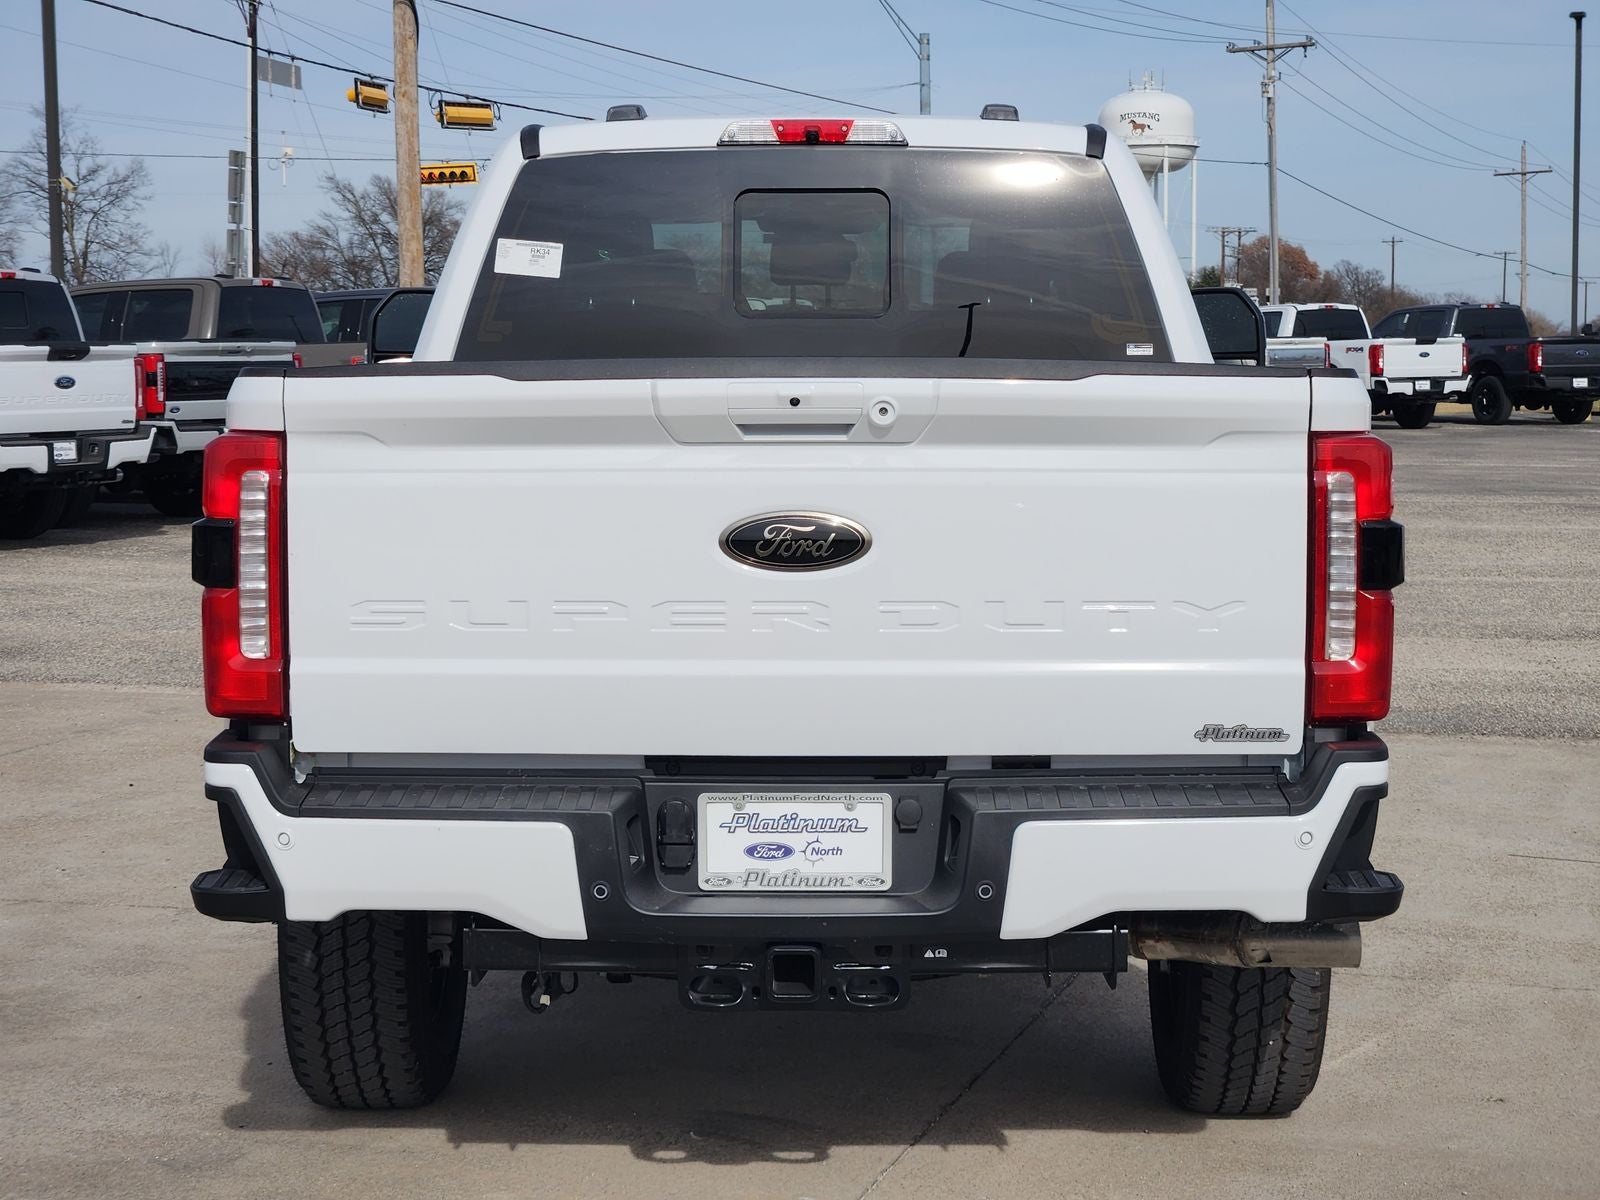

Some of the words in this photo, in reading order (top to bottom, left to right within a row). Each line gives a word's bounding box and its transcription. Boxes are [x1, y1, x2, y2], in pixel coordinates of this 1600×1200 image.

[1119, 112, 1160, 122] MUSTANG
[530, 247, 551, 255] RK34
[755, 523, 836, 559] Ford
[349, 600, 830, 632] SUPER
[878, 600, 1247, 632] DUTY
[1194, 723, 1291, 742] Platinum
[707, 793, 884, 802] www.PlatinumFordNorth.com
[719, 812, 868, 834] Platinum
[754, 844, 786, 858] Ford
[810, 845, 843, 856] North
[743, 869, 851, 888] Platinum
